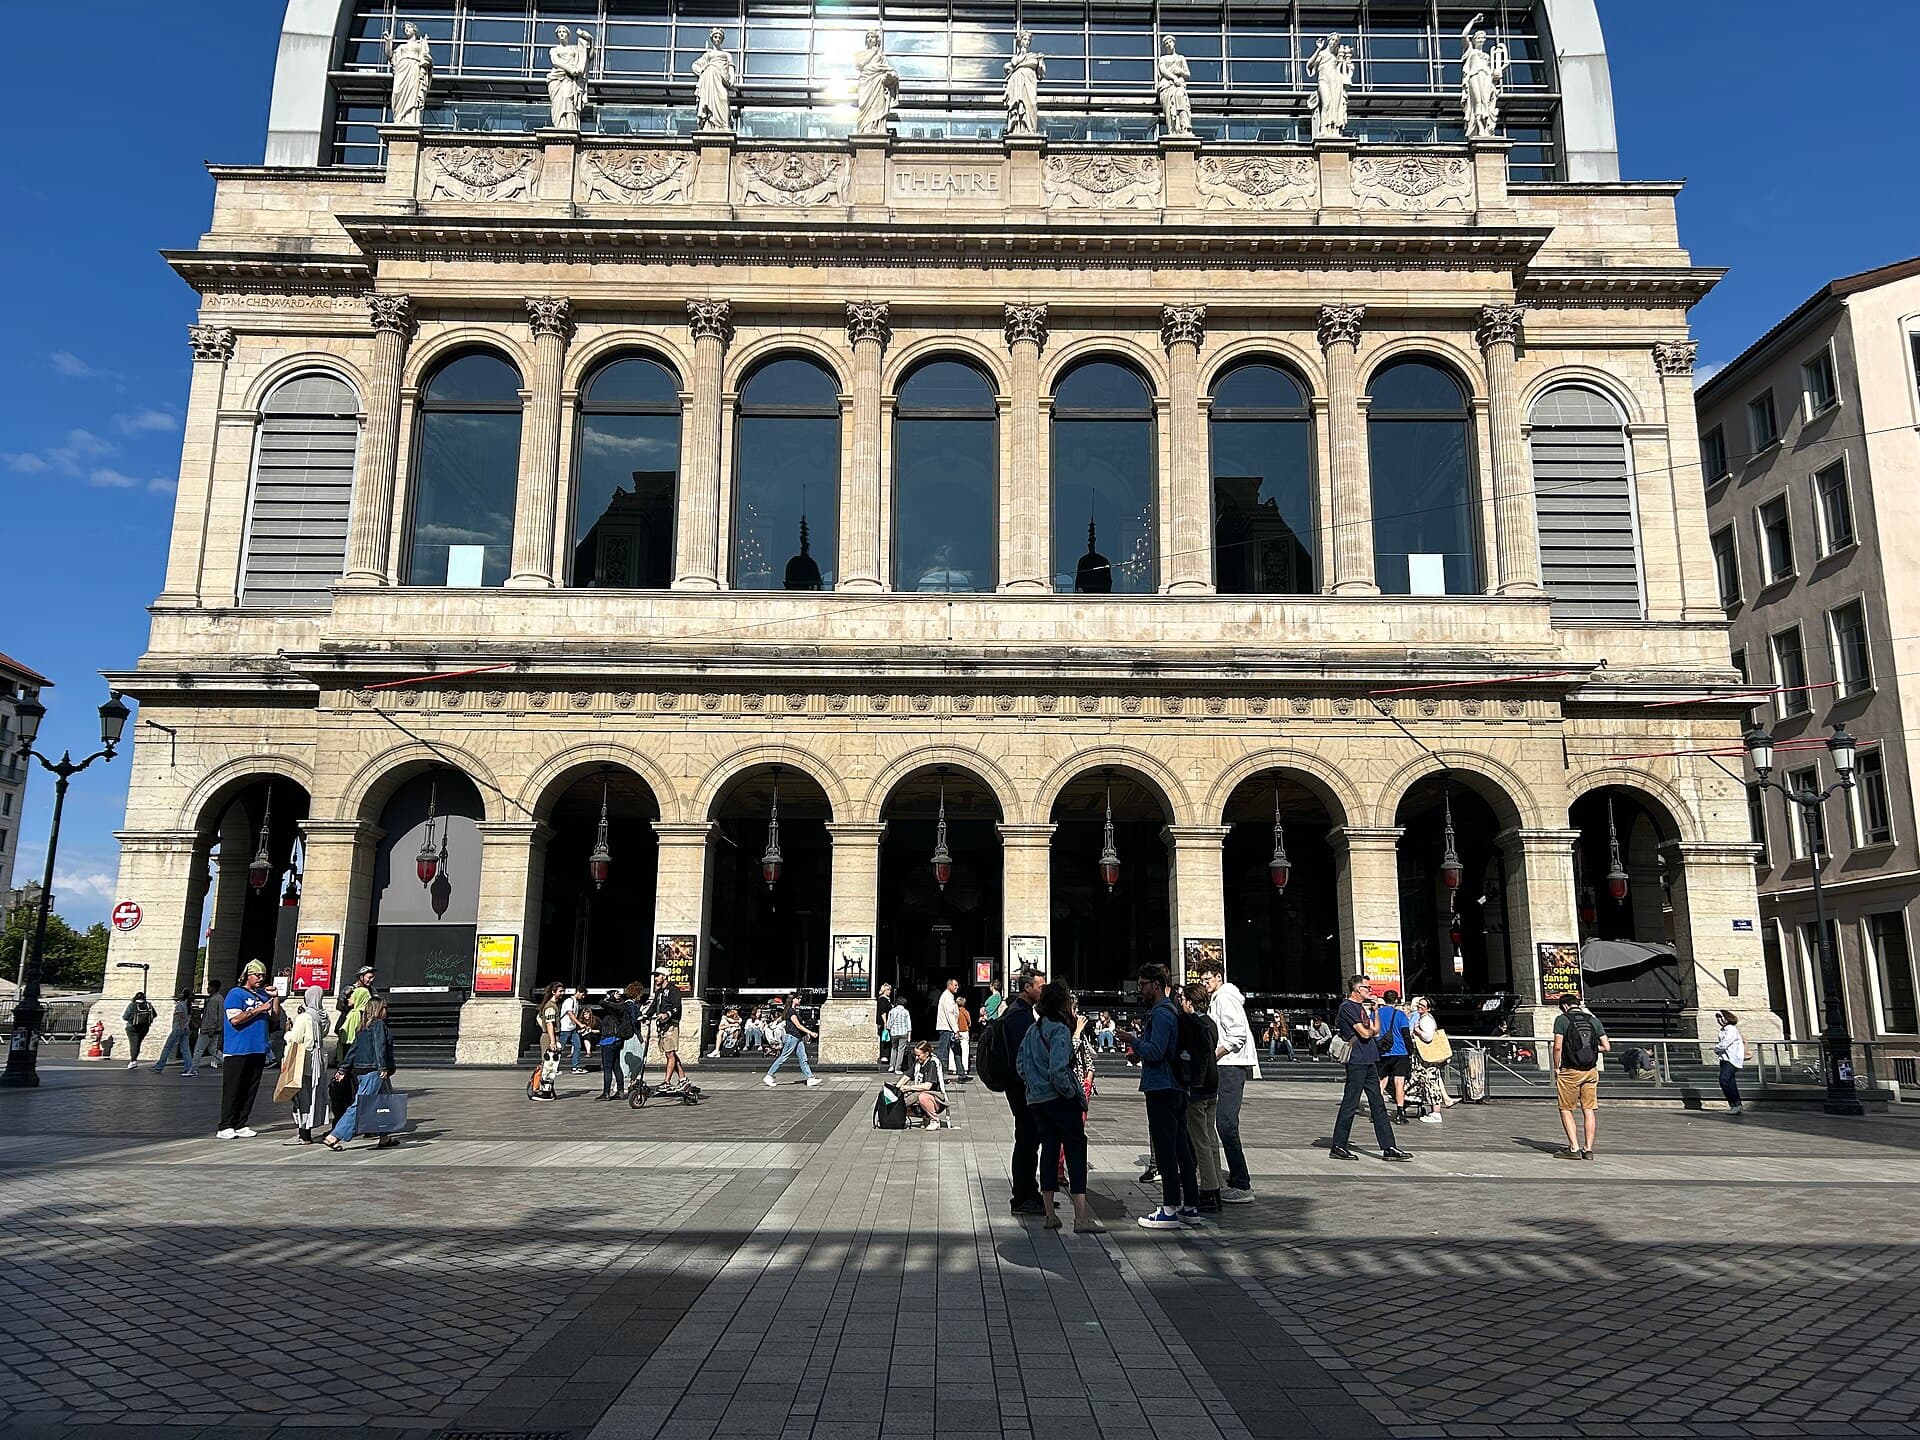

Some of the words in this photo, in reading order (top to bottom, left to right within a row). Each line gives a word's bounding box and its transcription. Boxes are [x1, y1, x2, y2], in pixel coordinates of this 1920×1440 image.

[896, 171, 999, 192] THEATRE
[297, 948, 312, 956] Les
[296, 956, 324, 965] Muses
[667, 958, 693, 968] opéra
[1553, 966, 1580, 976] opéra
[1364, 973, 1401, 983] éristyle
[1543, 974, 1569, 982] danse
